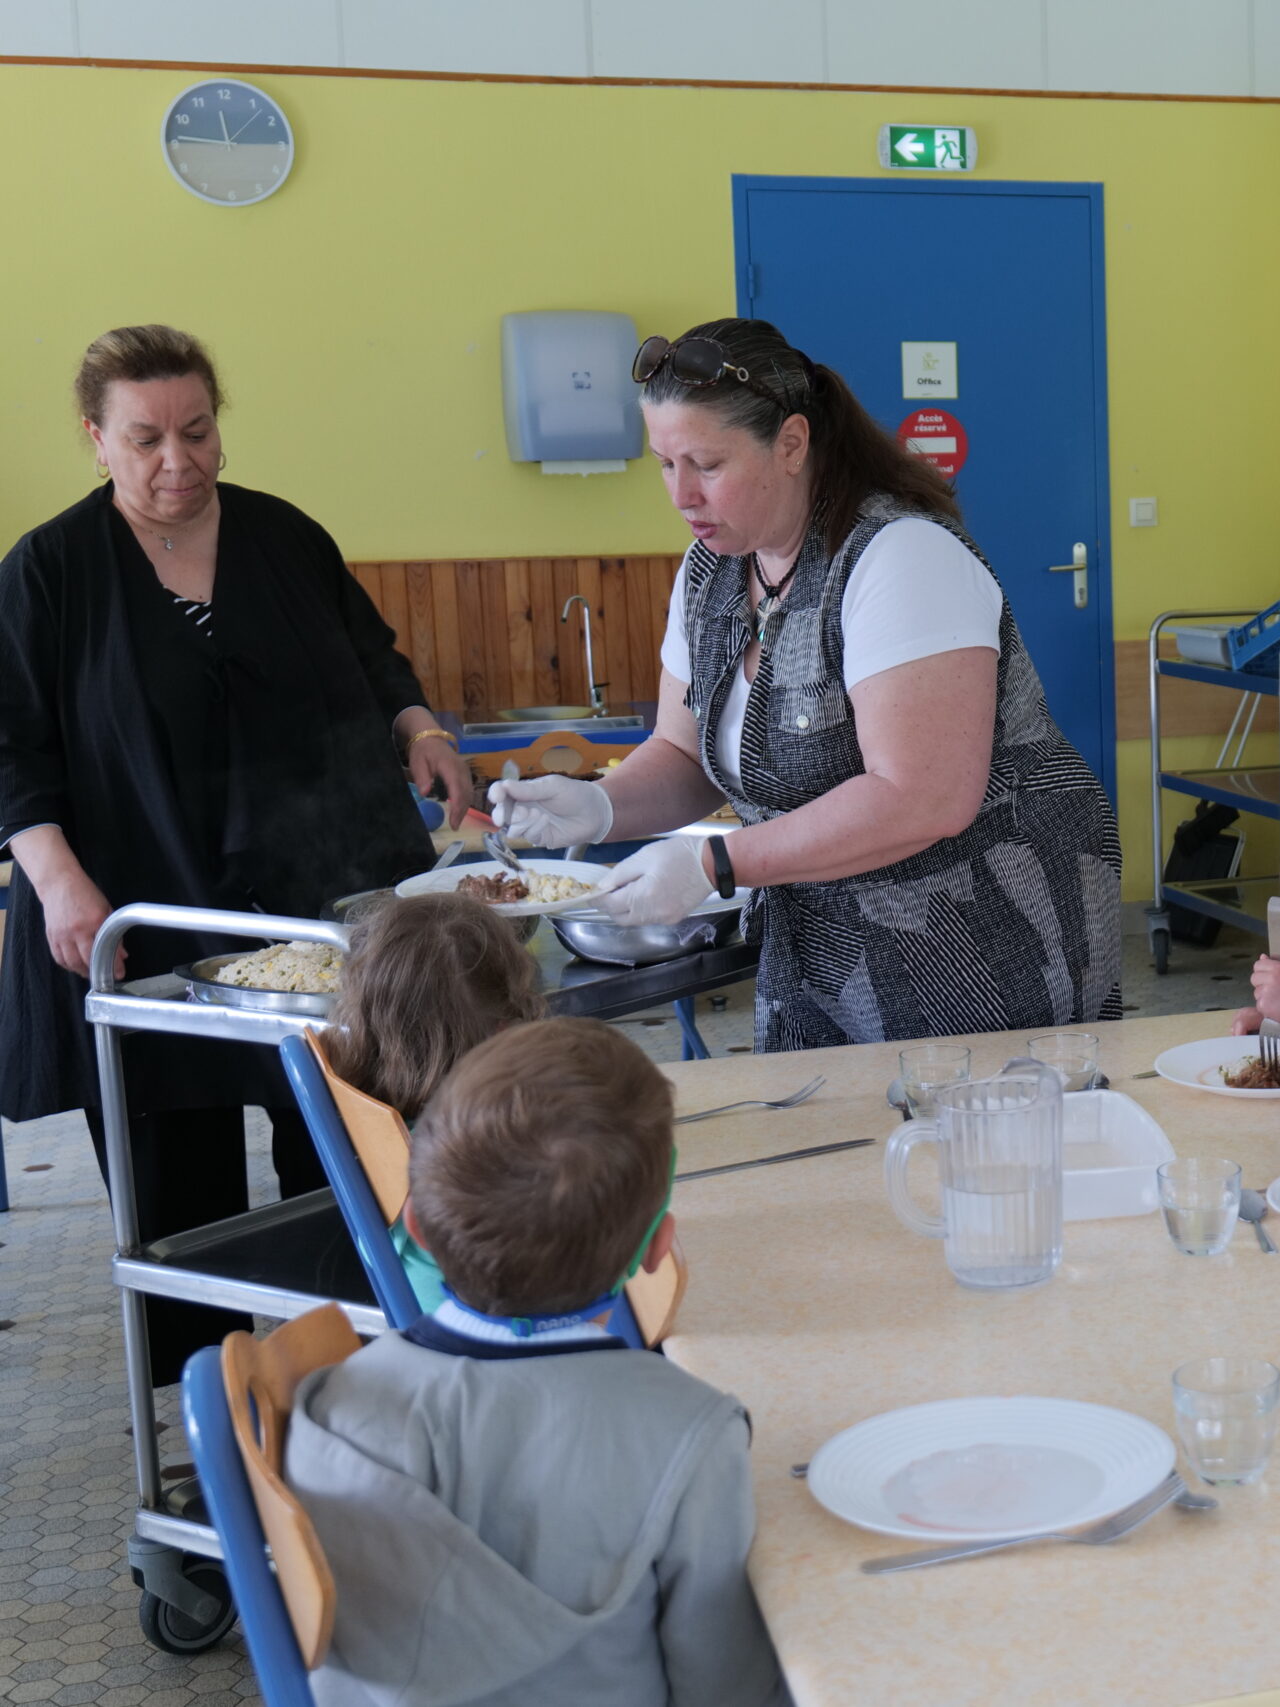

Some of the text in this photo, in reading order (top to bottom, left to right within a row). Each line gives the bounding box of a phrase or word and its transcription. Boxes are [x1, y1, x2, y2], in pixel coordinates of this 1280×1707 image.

[217, 89, 231, 100] 12
[192, 97, 205, 108] 11
[249, 98, 256, 109] 1
[175, 113, 190, 125] 10
[267, 115, 276, 127] 2
[170, 139, 179, 150] 9
[278, 141, 286, 151] 3
[255, 183, 263, 194] 5
[227, 190, 236, 201] 6
[917, 377, 942, 386] Office
[918, 414, 943, 423] Accès
[914, 422, 947, 432] réservé
